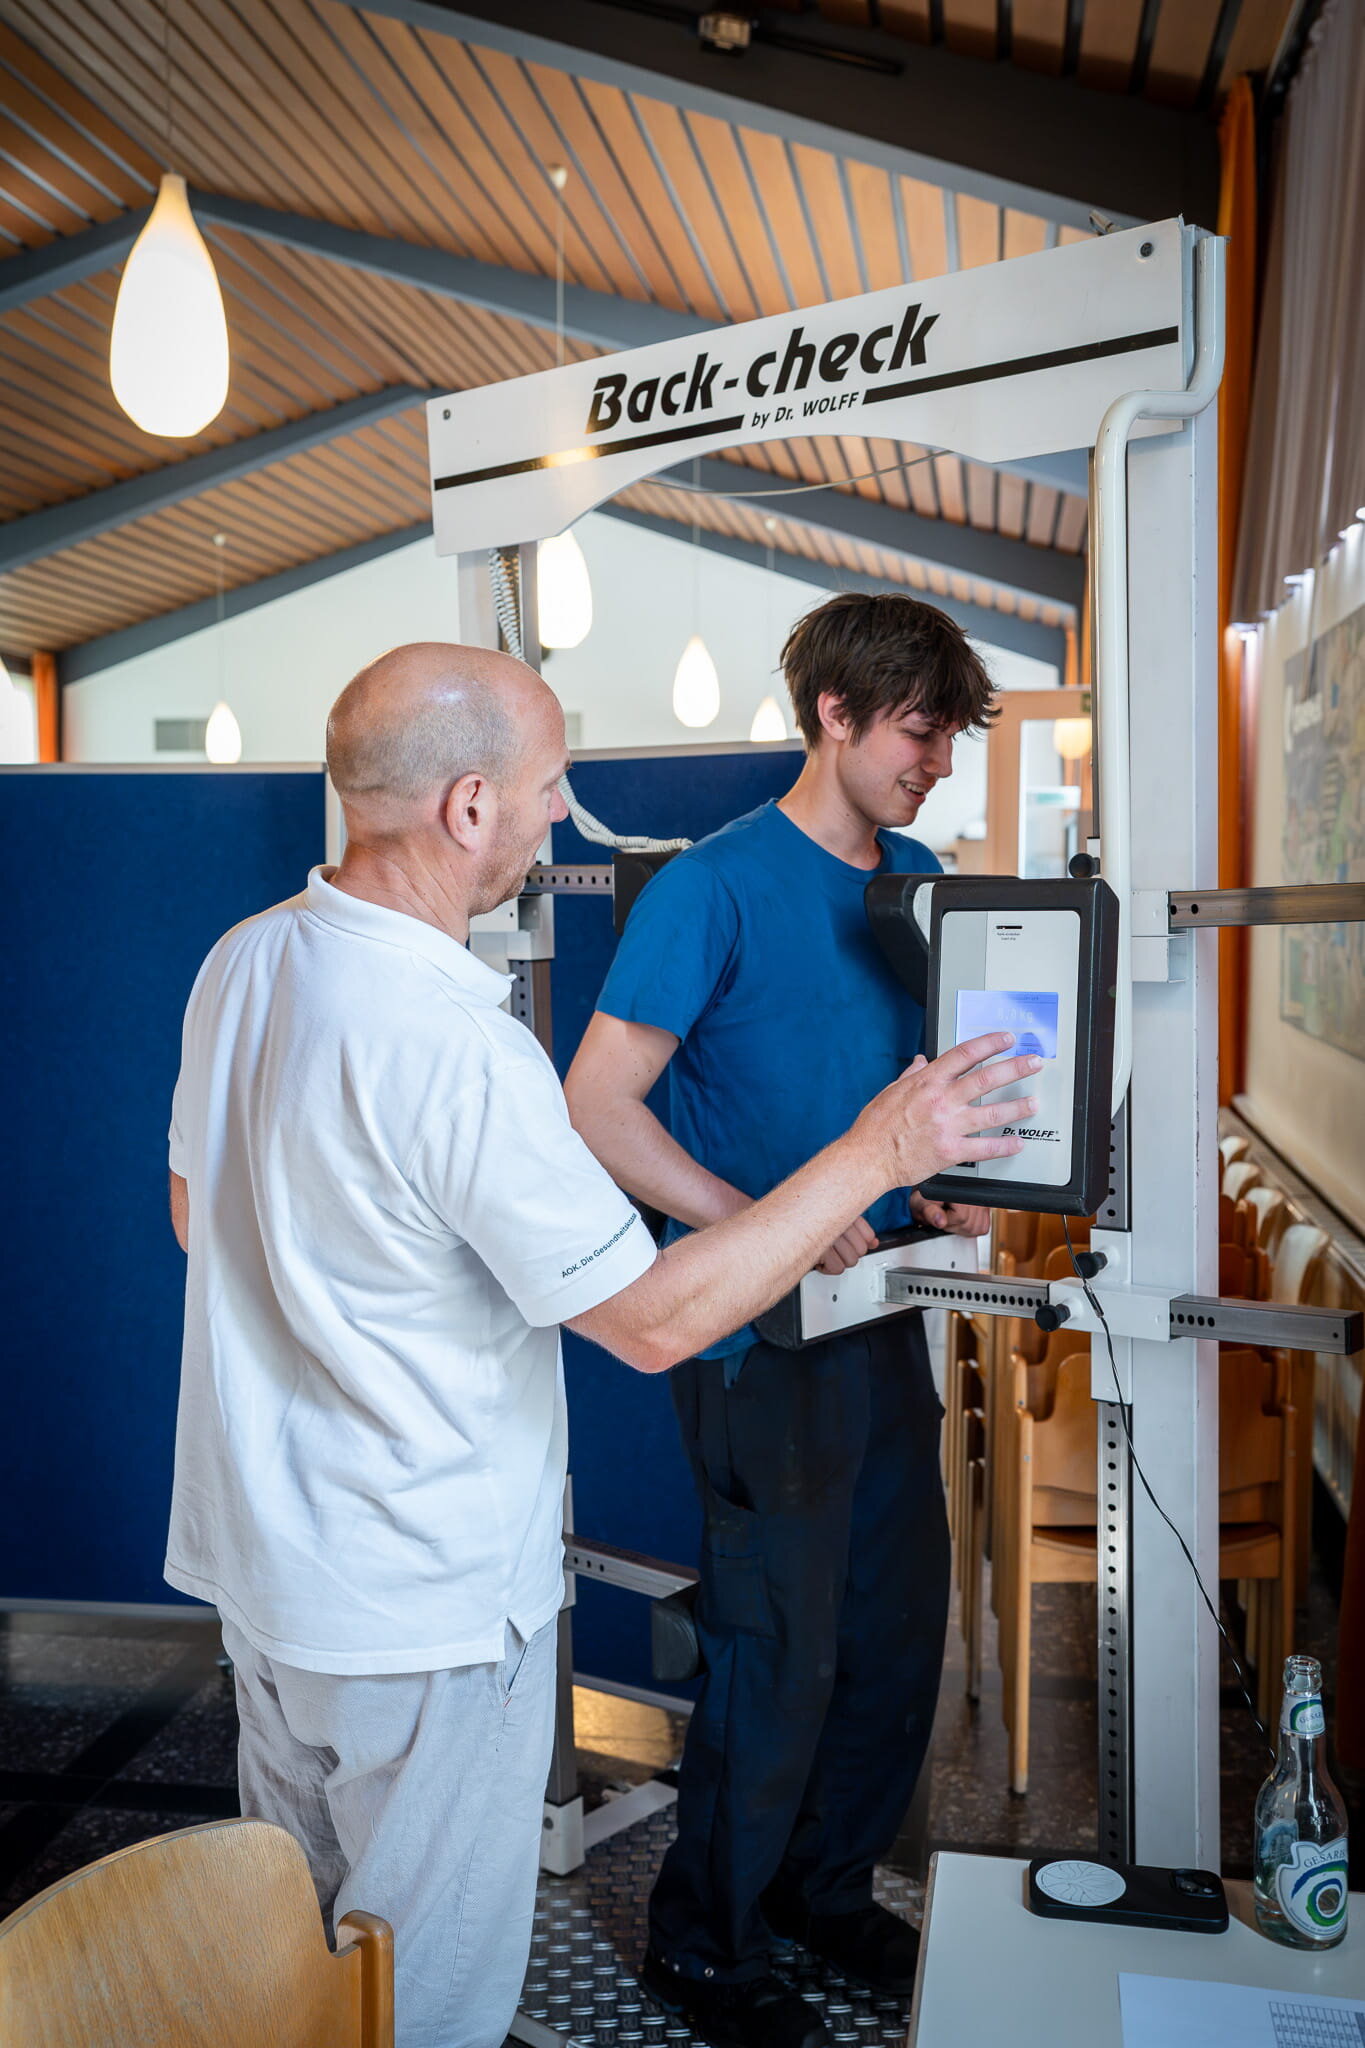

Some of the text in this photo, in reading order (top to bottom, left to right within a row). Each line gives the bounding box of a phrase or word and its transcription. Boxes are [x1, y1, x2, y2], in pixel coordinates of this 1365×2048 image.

[585, 303, 941, 434] Back-check
[751, 391, 860, 429] by Dr. WOLFF
[1002, 1127, 1055, 1138] Dr. WOLFF
[561, 1263, 582, 1279] AOK.
[580, 1254, 594, 1267] Die
